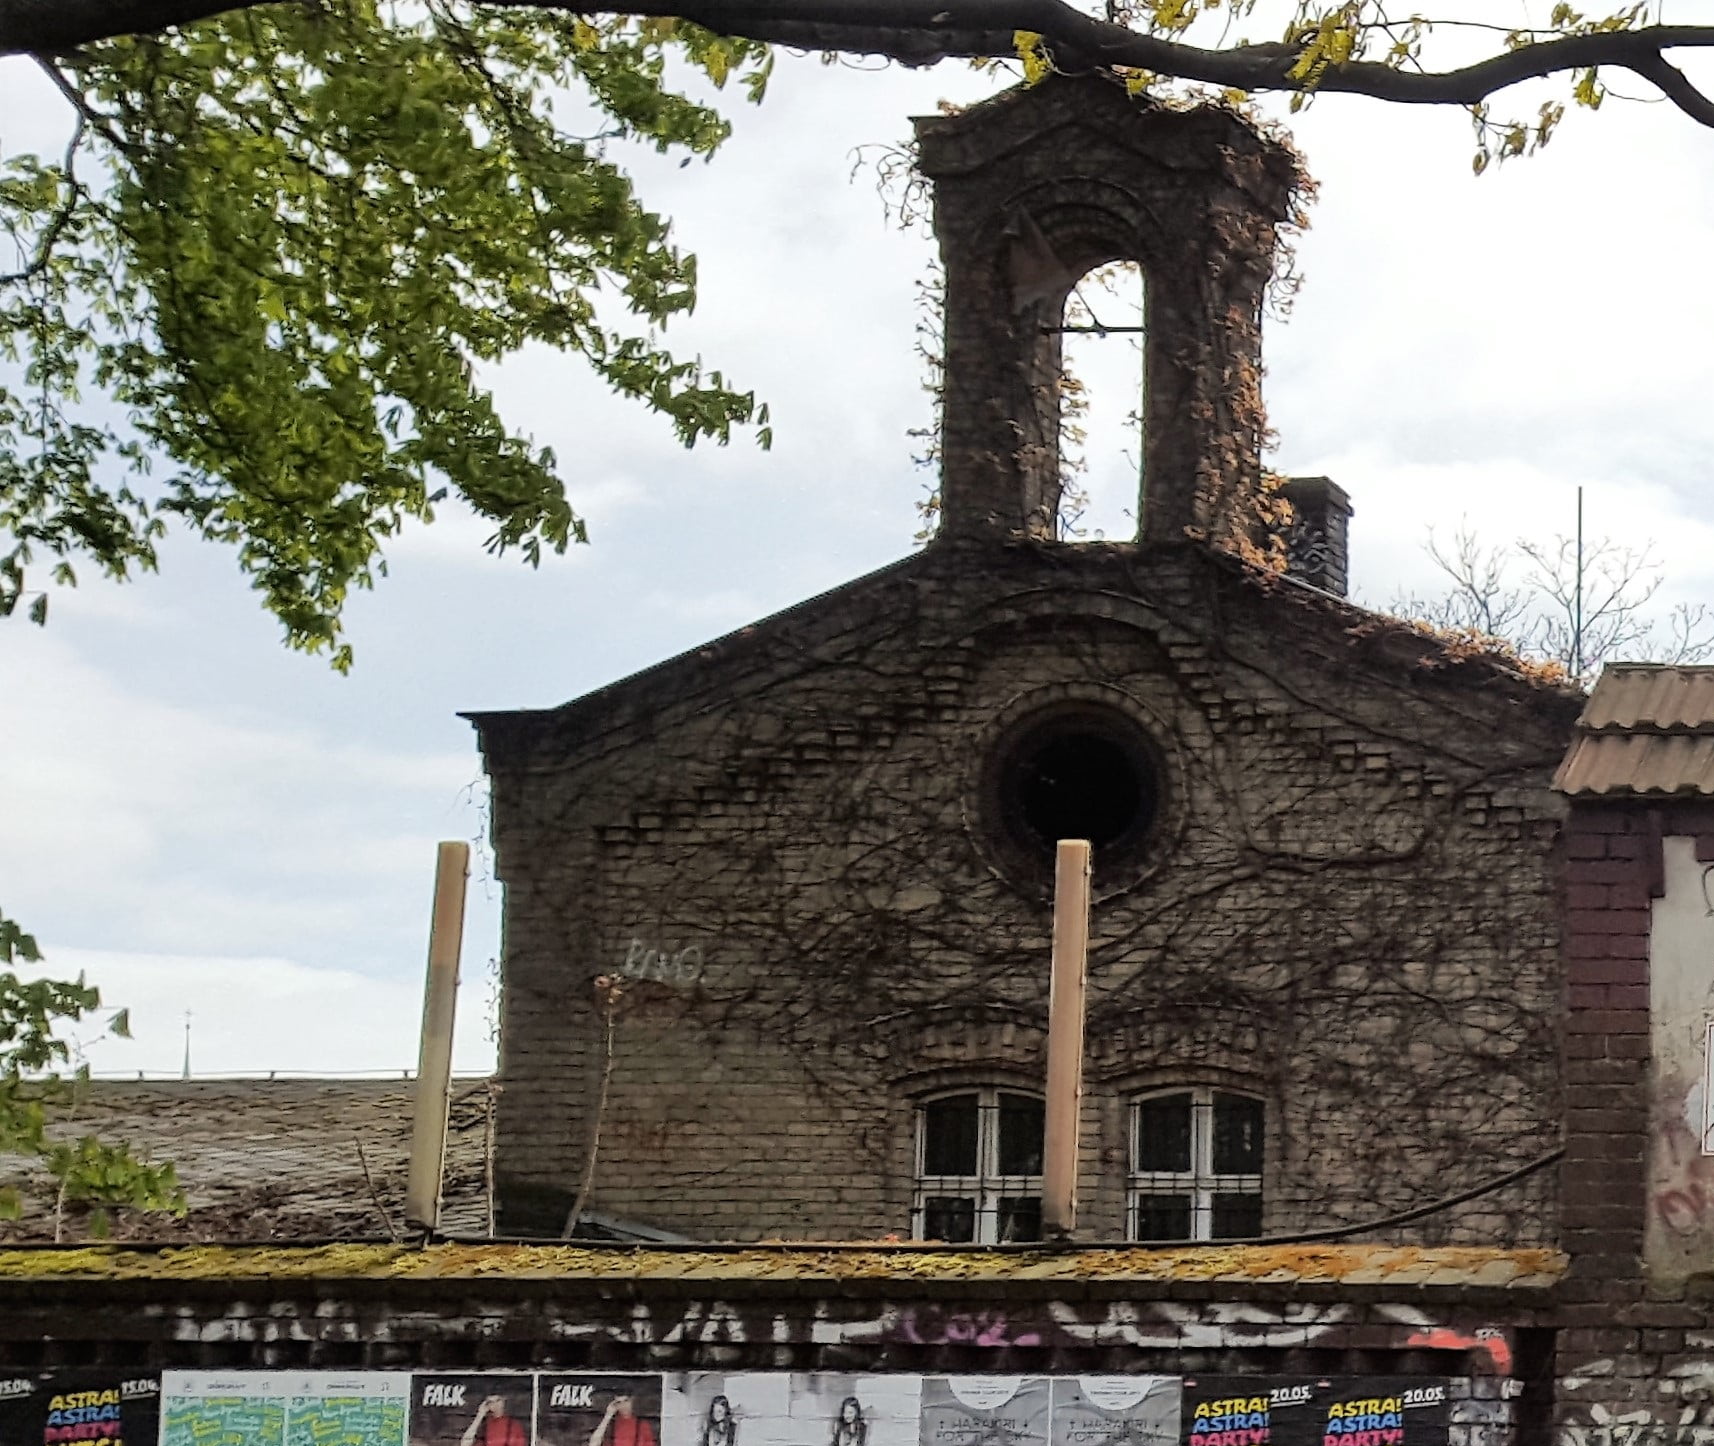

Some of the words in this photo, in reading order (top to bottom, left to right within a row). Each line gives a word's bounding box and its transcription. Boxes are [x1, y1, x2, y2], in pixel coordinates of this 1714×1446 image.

[49, 1389, 120, 1411] ASTRA!
[1270, 1387, 1312, 1402] 20.05.
[1403, 1387, 1445, 1402] 20.05.
[47, 1404, 121, 1425] ASTRA!
[1195, 1397, 1270, 1417] ASTRA!
[1328, 1397, 1403, 1418] ASTRA!
[1192, 1412, 1271, 1433] ASTRA!
[1325, 1413, 1404, 1434] ASTRA!
